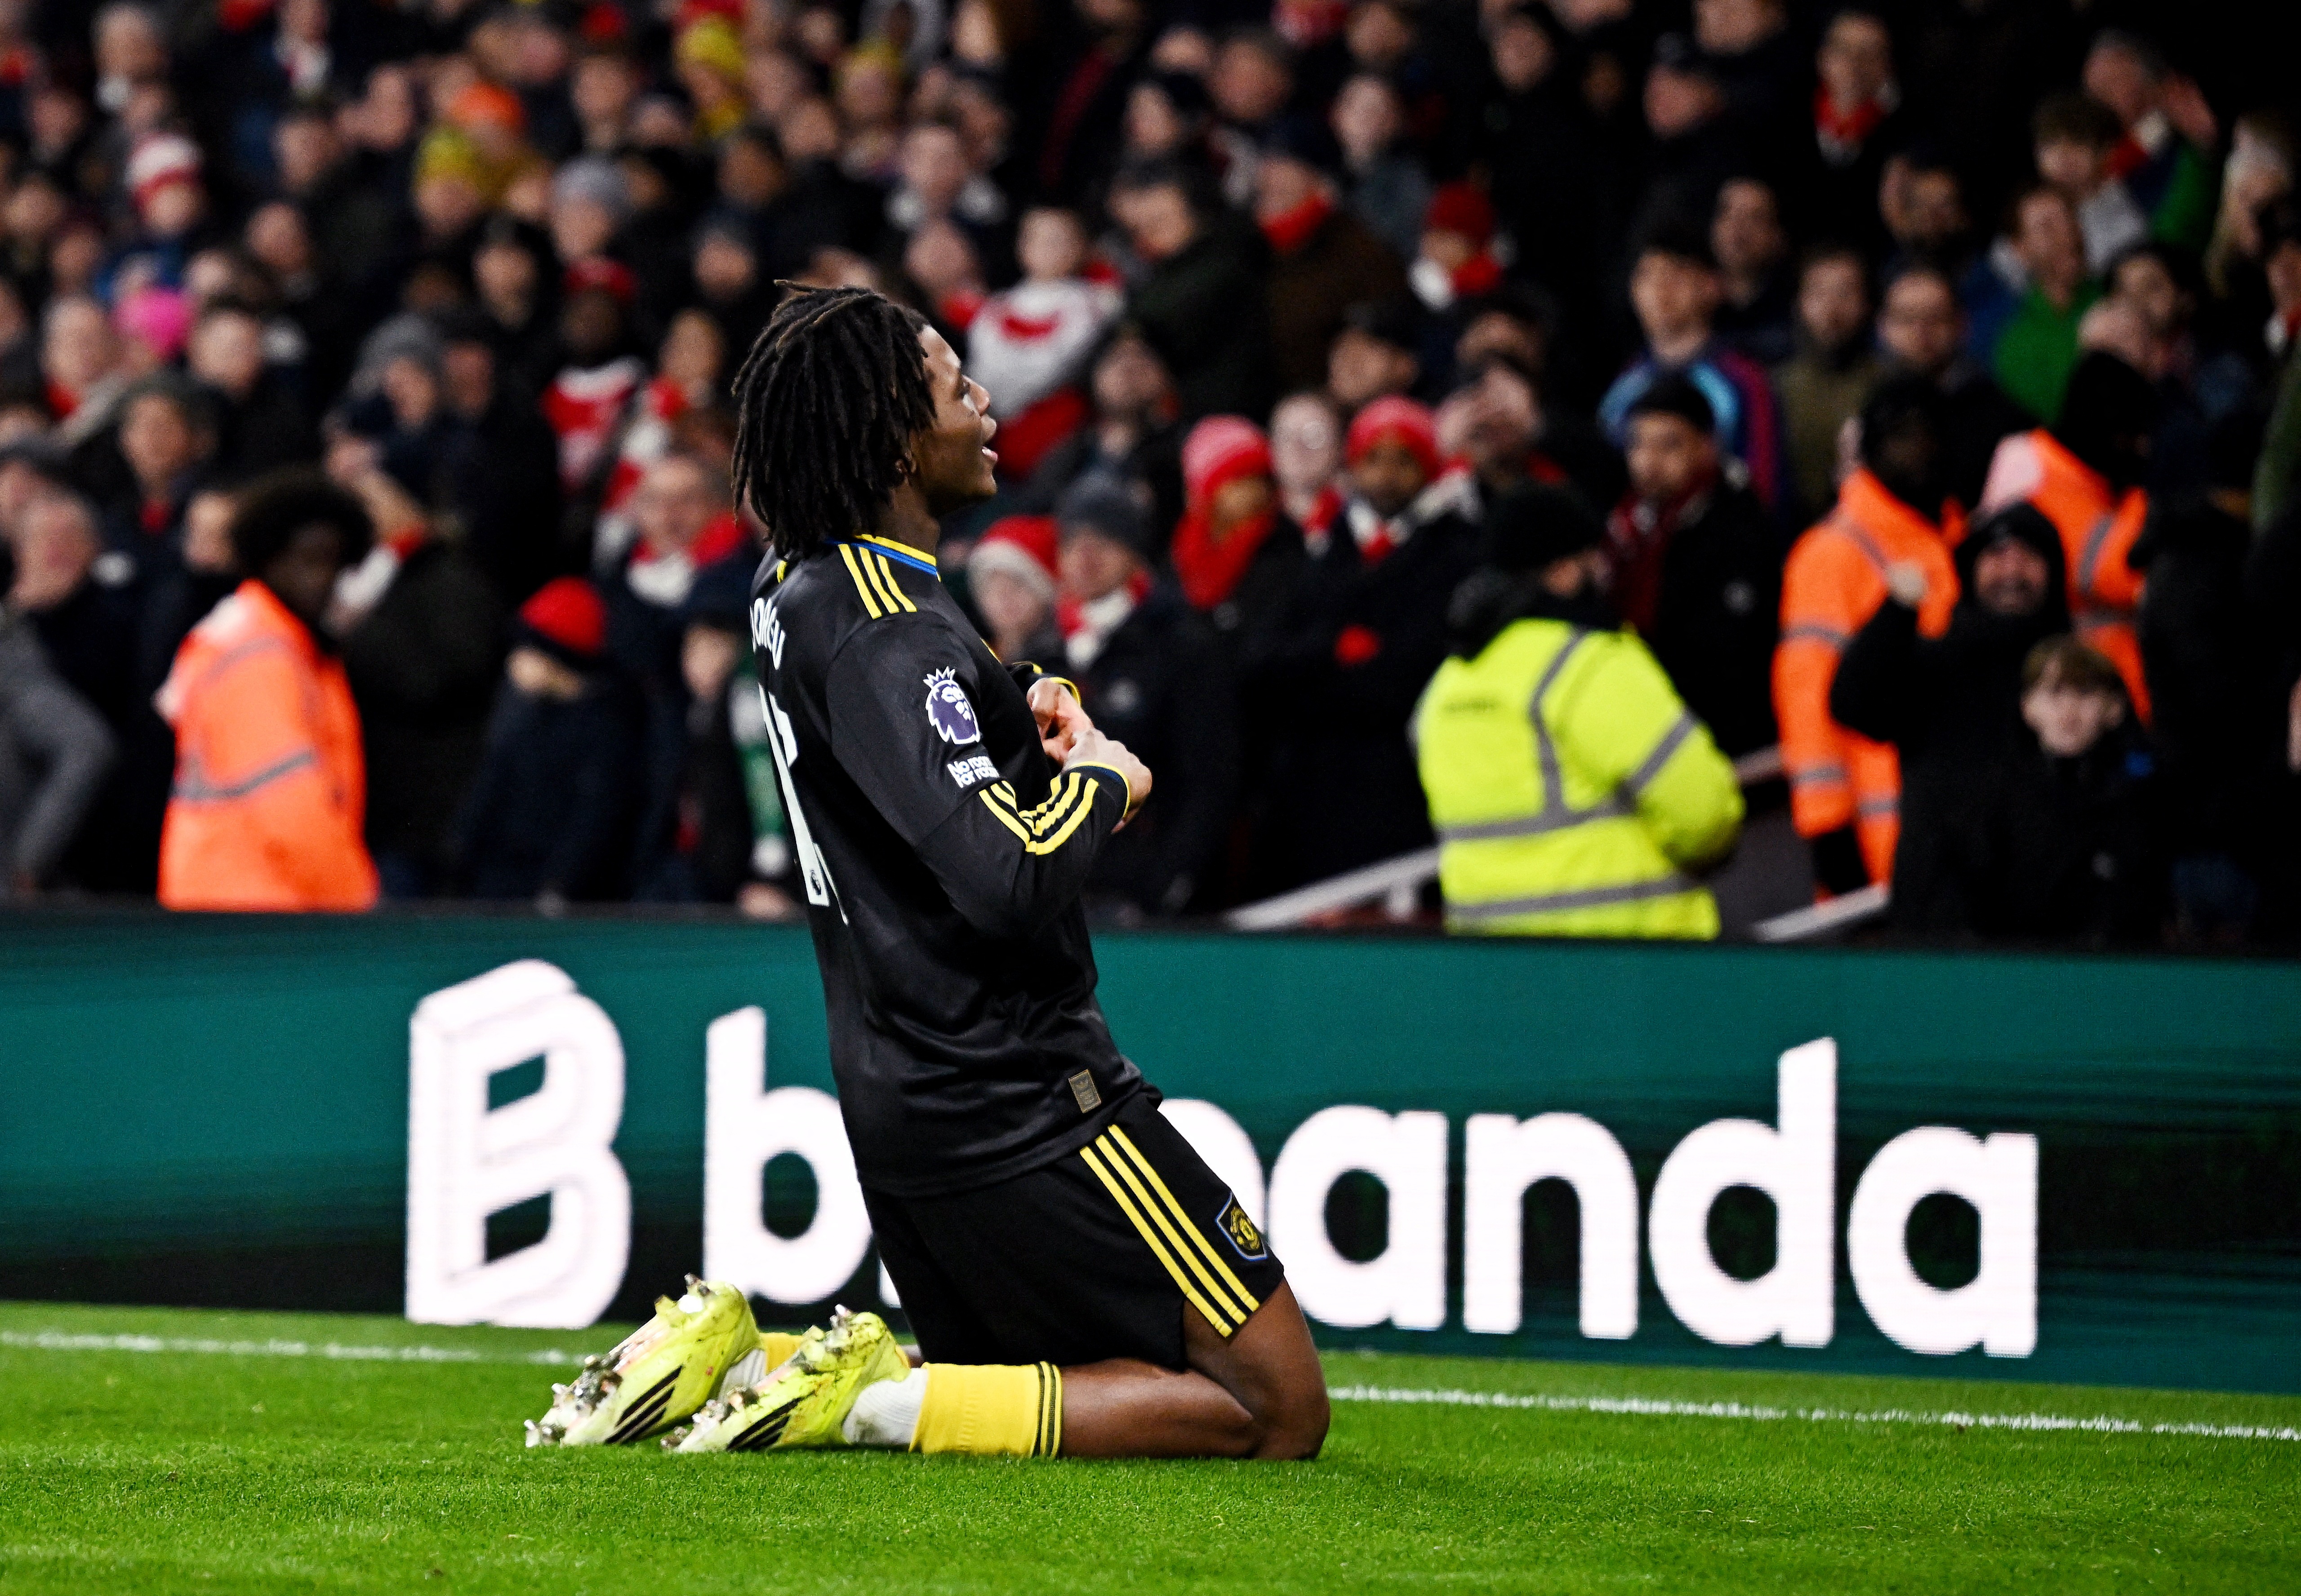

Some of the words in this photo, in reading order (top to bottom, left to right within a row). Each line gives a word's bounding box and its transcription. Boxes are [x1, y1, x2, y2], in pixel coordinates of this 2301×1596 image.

[947, 760, 970, 775] No
[954, 770, 975, 788] for
[703, 1007, 2039, 1358] banda
